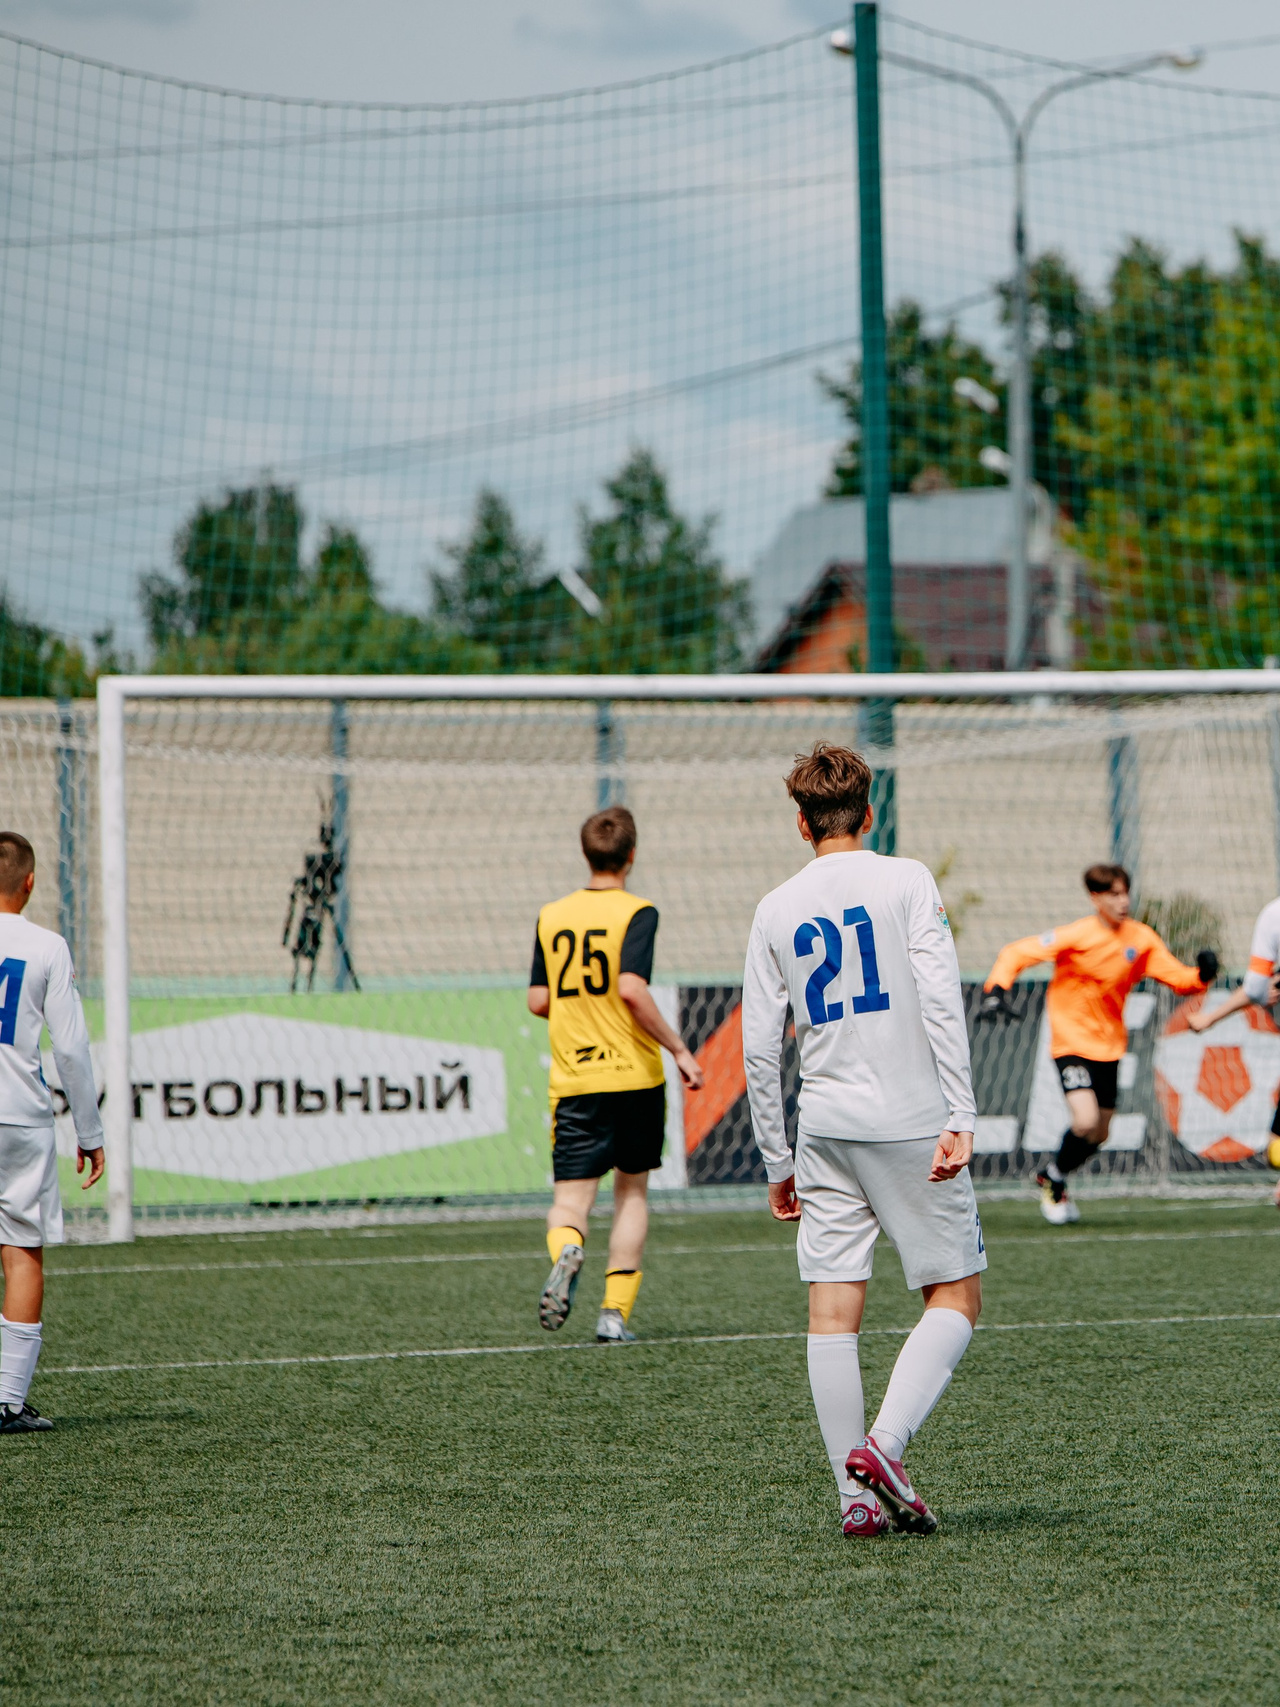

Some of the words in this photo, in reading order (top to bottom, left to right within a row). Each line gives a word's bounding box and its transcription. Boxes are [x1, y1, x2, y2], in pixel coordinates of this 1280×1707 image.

[552, 929, 609, 998] 25
[793, 905, 890, 1026] 21
[53, 1061, 472, 1121] ТБОЛЬНЫЙ
